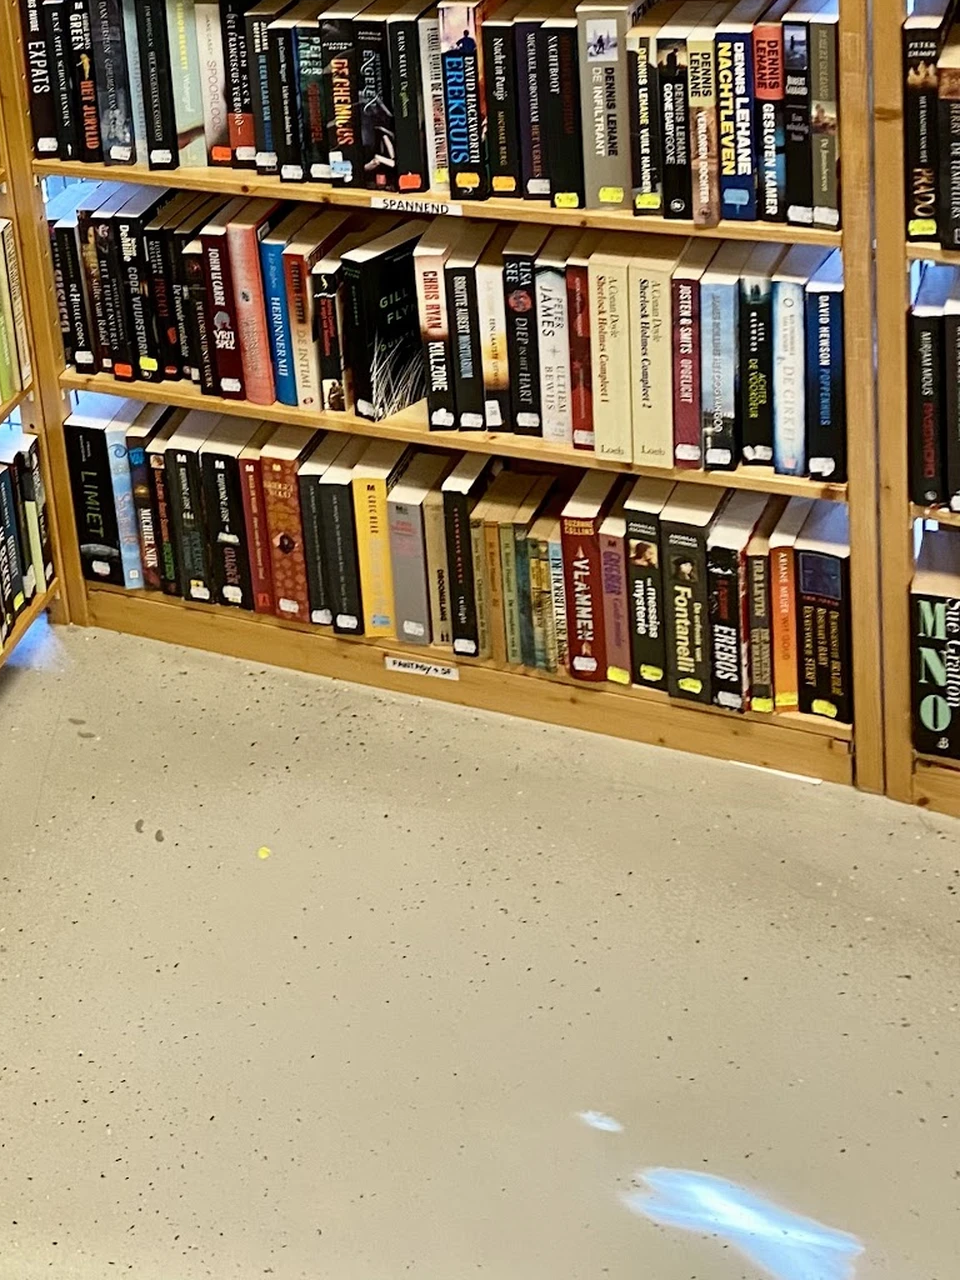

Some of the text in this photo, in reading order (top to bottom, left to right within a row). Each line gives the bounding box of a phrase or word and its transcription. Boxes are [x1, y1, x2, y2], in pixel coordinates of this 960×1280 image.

[27, 40, 50, 94] EXPATS
[603, 66, 620, 158] DENNIS LEHANE
[718, 40, 737, 177] NACHTLEVEN
[762, 103, 778, 216] GESLOTEN KAMER
[382, 199, 450, 215] SPANNEND
[422, 270, 442, 331] CHRIS RYAN
[540, 285, 555, 338] JAMES
[428, 341, 448, 392] KILLZONE
[79, 470, 104, 538] LIMIET
[572, 559, 594, 642] VLAMMEN
[673, 585, 695, 674] Fontanelli
[713, 624, 738, 683] EREBOS
